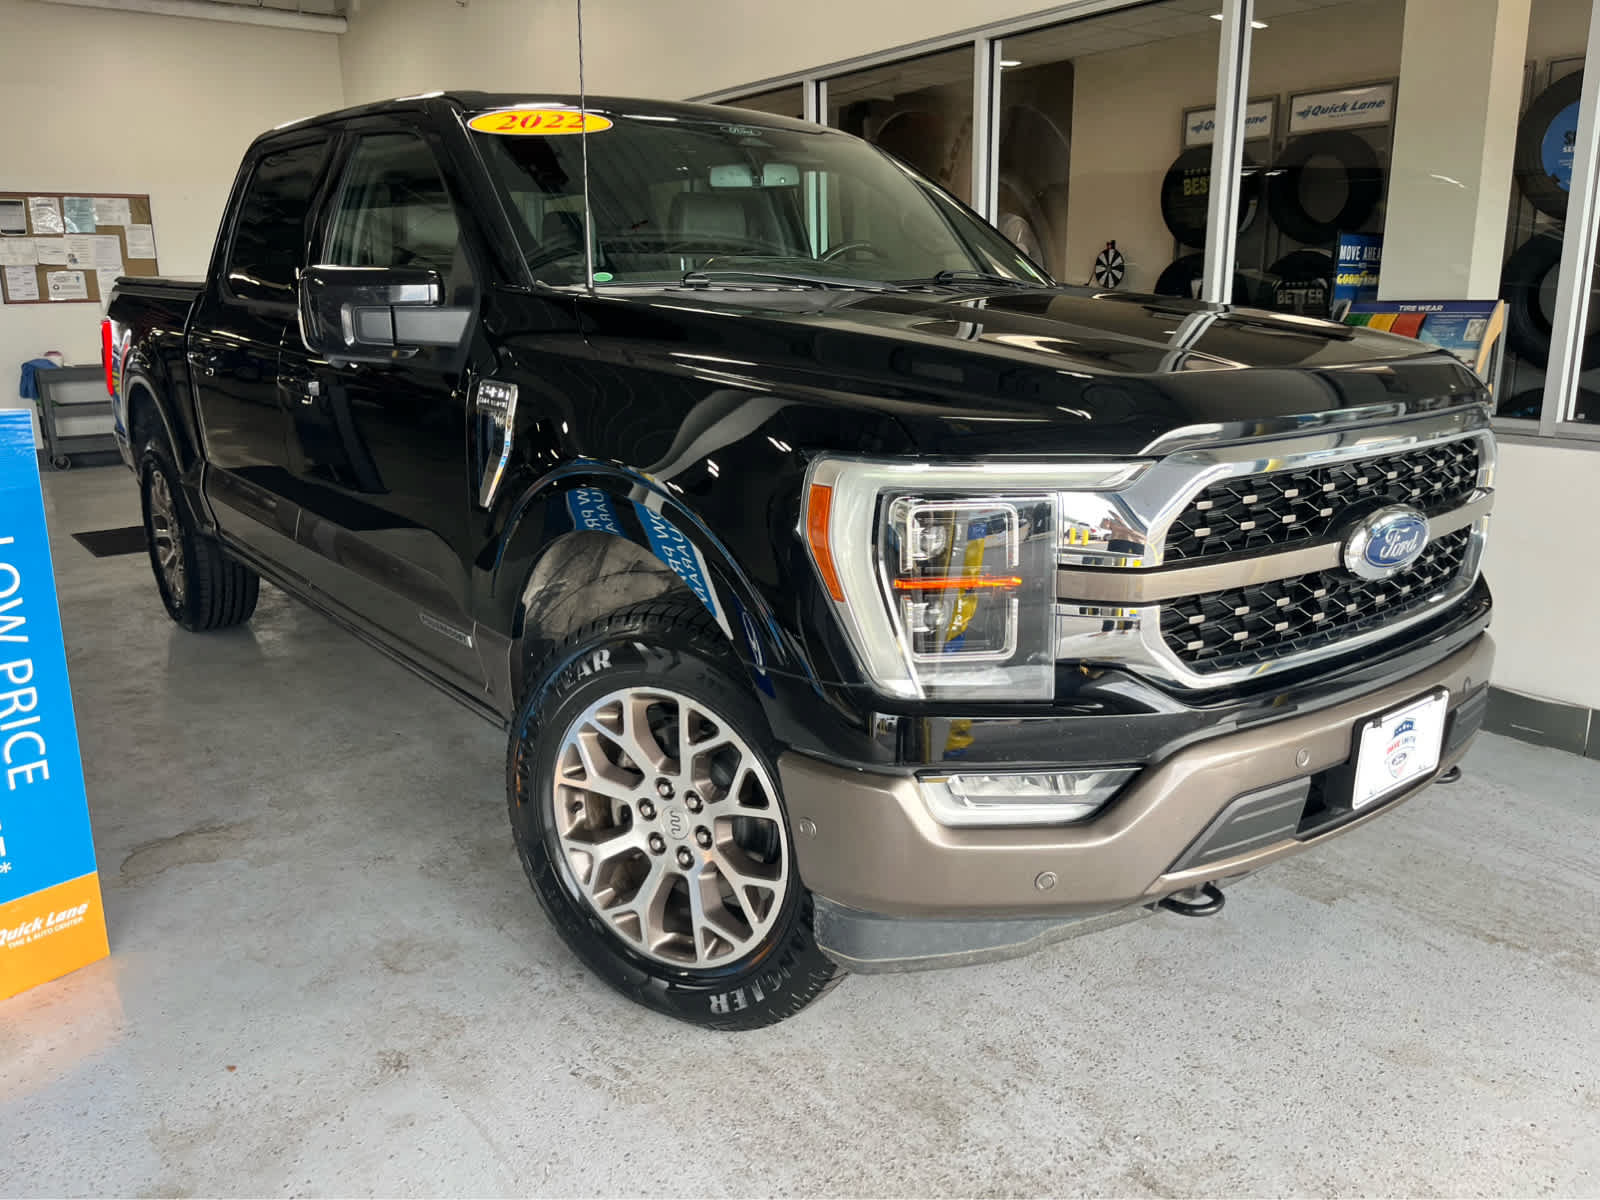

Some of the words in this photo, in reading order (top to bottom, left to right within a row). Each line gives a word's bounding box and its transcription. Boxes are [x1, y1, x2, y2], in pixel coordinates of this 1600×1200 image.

[1311, 102, 1348, 116] Quick
[1350, 99, 1386, 110] Lane
[495, 113, 587, 131] 2022
[1339, 245, 1361, 260] MOVE
[1276, 288, 1325, 305] BETTER
[1380, 527, 1419, 559] Ford
[0, 657, 50, 791] PRICE
[46, 903, 88, 927] Lane
